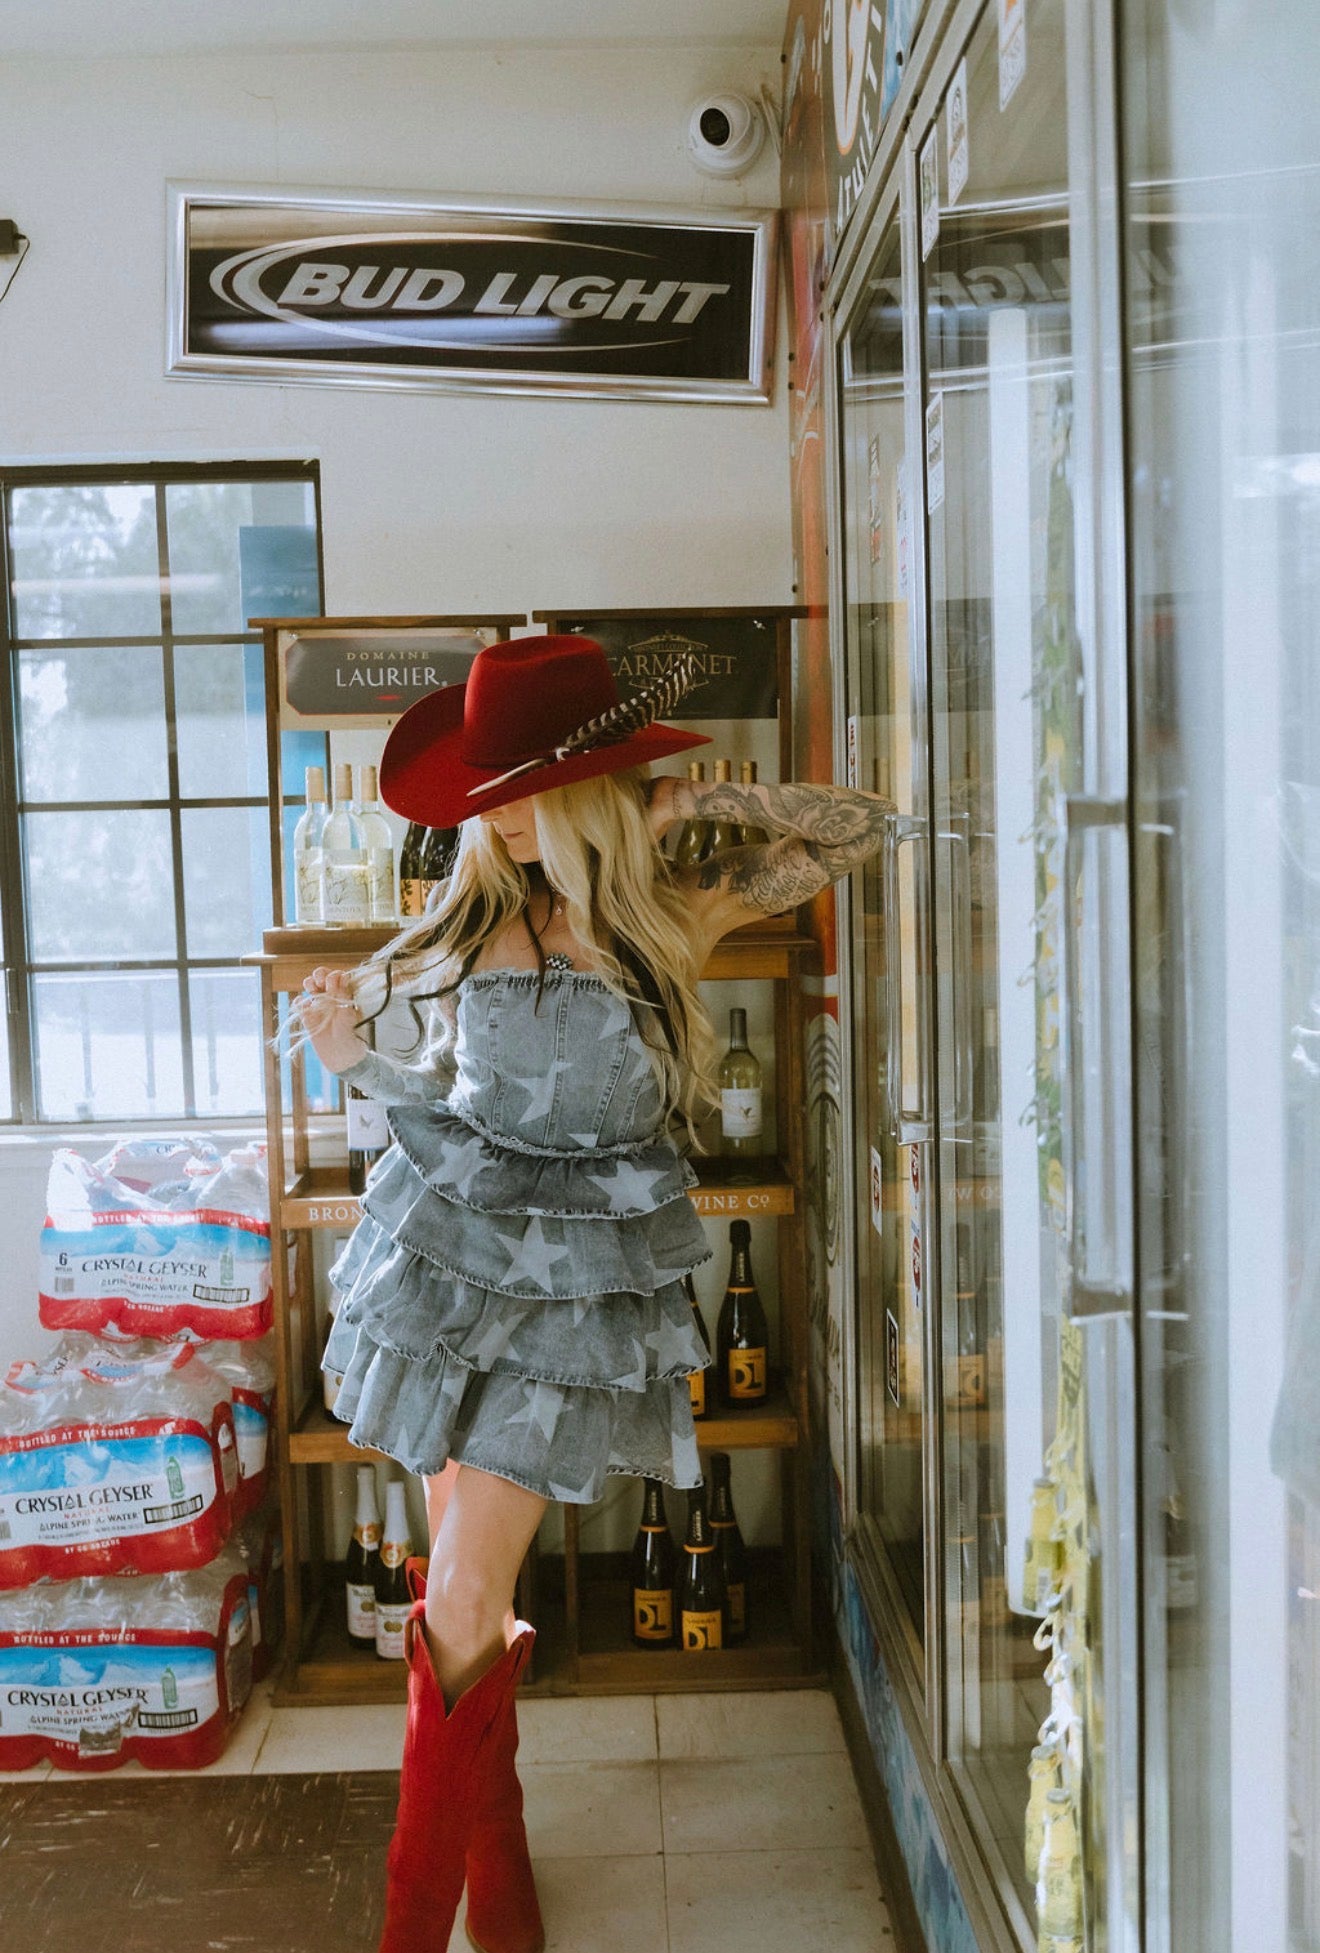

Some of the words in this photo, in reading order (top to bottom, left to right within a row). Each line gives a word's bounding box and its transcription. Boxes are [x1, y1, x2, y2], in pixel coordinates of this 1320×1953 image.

[277, 263, 466, 310] BUD
[473, 272, 731, 325] LIGHT
[346, 651, 430, 661] DOMAINE
[607, 653, 737, 677] ARMNET
[58, 1252, 68, 1266] 6
[81, 1257, 145, 1274] CRYSTAL
[148, 1260, 208, 1279] GEYSER
[19, 1433, 57, 1449] BOTTLED
[61, 1430, 74, 1441] AT
[15, 1493, 83, 1515] CRYSTAL
[88, 1483, 154, 1505] GEYSER
[39, 1521, 69, 1532] ALPINE
[107, 1511, 140, 1522] WATER
[13, 1634, 55, 1645] BOTTLED
[58, 1634, 70, 1645] AT
[74, 1633, 93, 1643] THE
[97, 1631, 137, 1643] SOURCE
[7, 1689, 82, 1709] CRYSTAL
[82, 1687, 149, 1707] GEYSER
[30, 1714, 62, 1725] ALPINE
[63, 1714, 98, 1726] SPRING
